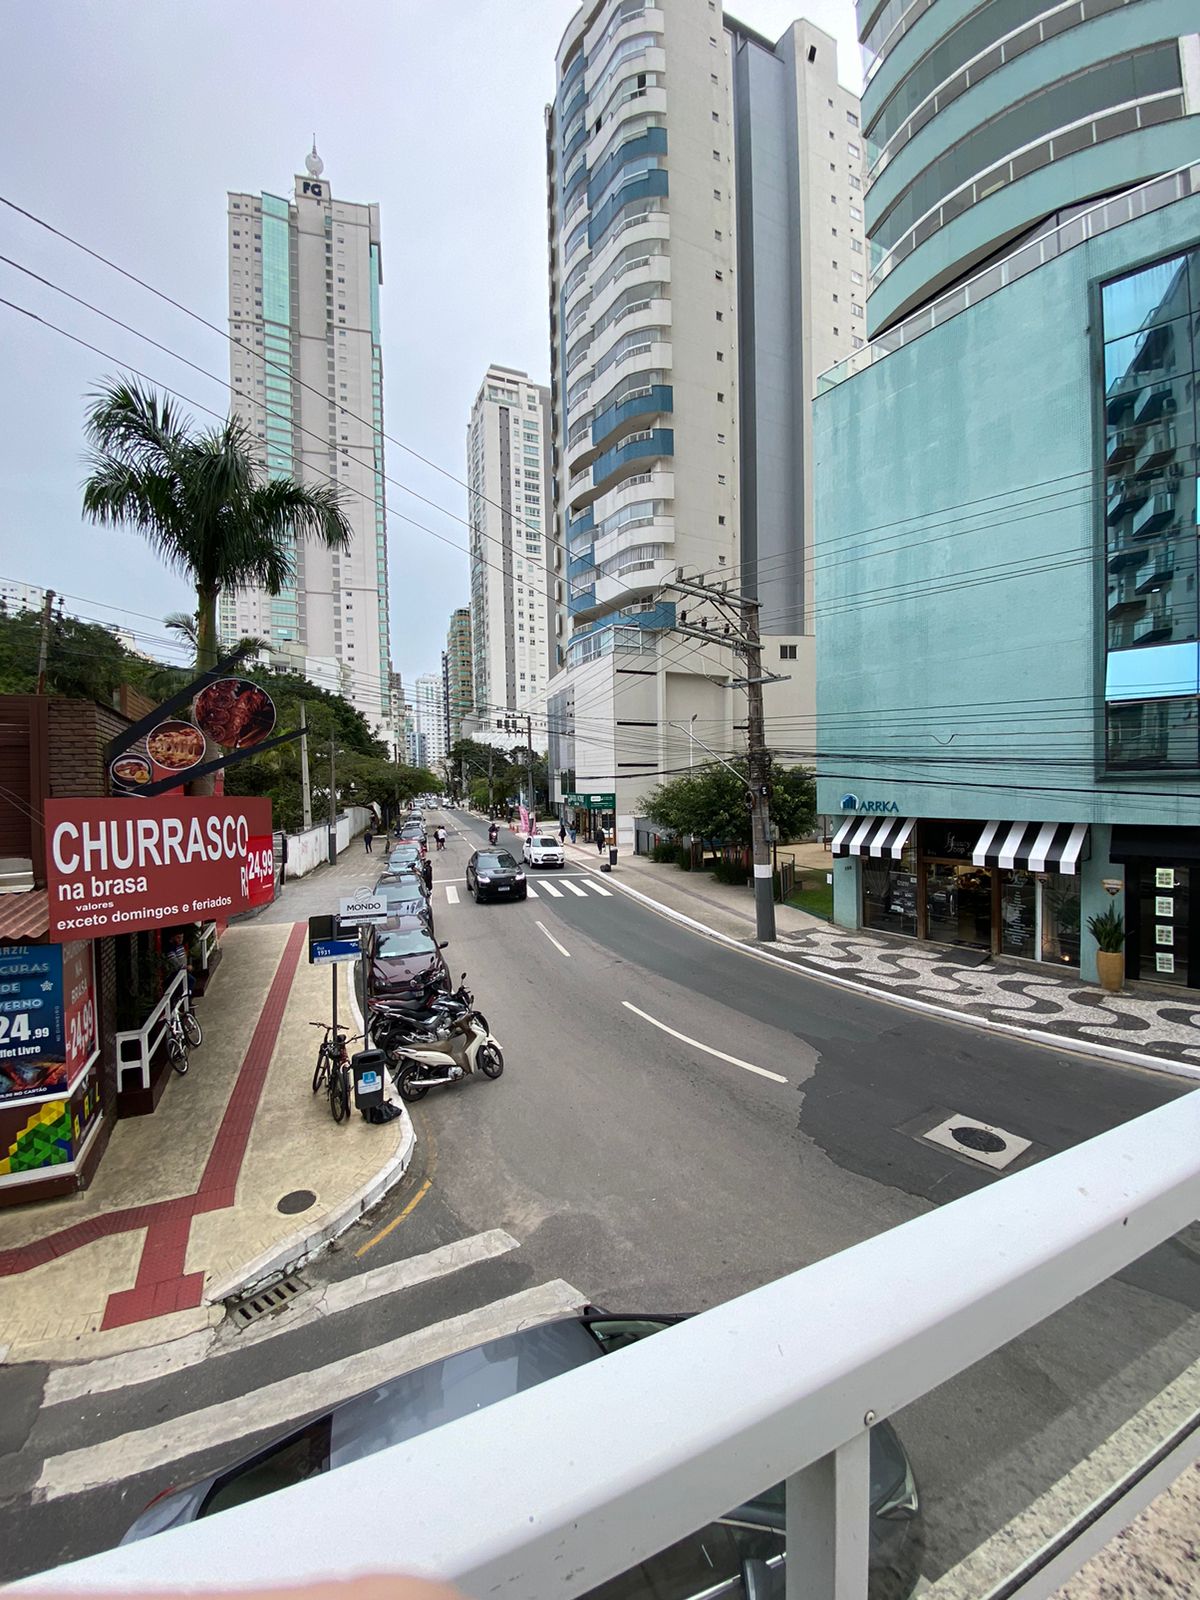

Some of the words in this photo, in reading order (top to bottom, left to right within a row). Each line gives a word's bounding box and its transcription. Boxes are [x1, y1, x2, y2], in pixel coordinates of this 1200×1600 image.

[303, 182, 322, 197] FG
[860, 800, 899, 813] ARRKA
[52, 815, 249, 875] CHURRASCO
[248, 849, 273, 883] 24,99
[58, 882, 85, 901] na
[91, 876, 148, 898] brasa
[57, 911, 107, 930] exceto
[111, 906, 179, 923] domingos
[182, 904, 189, 912] e
[192, 895, 232, 911] feriados
[75, 901, 114, 912] valores
[346, 902, 381, 912] MONDO
[0, 945, 29, 955] RZIL
[317, 949, 331, 957] 1931
[1, 982, 20, 993] DE
[70, 1000, 94, 1060] 24,99
[18, 1045, 41, 1056] Livre
